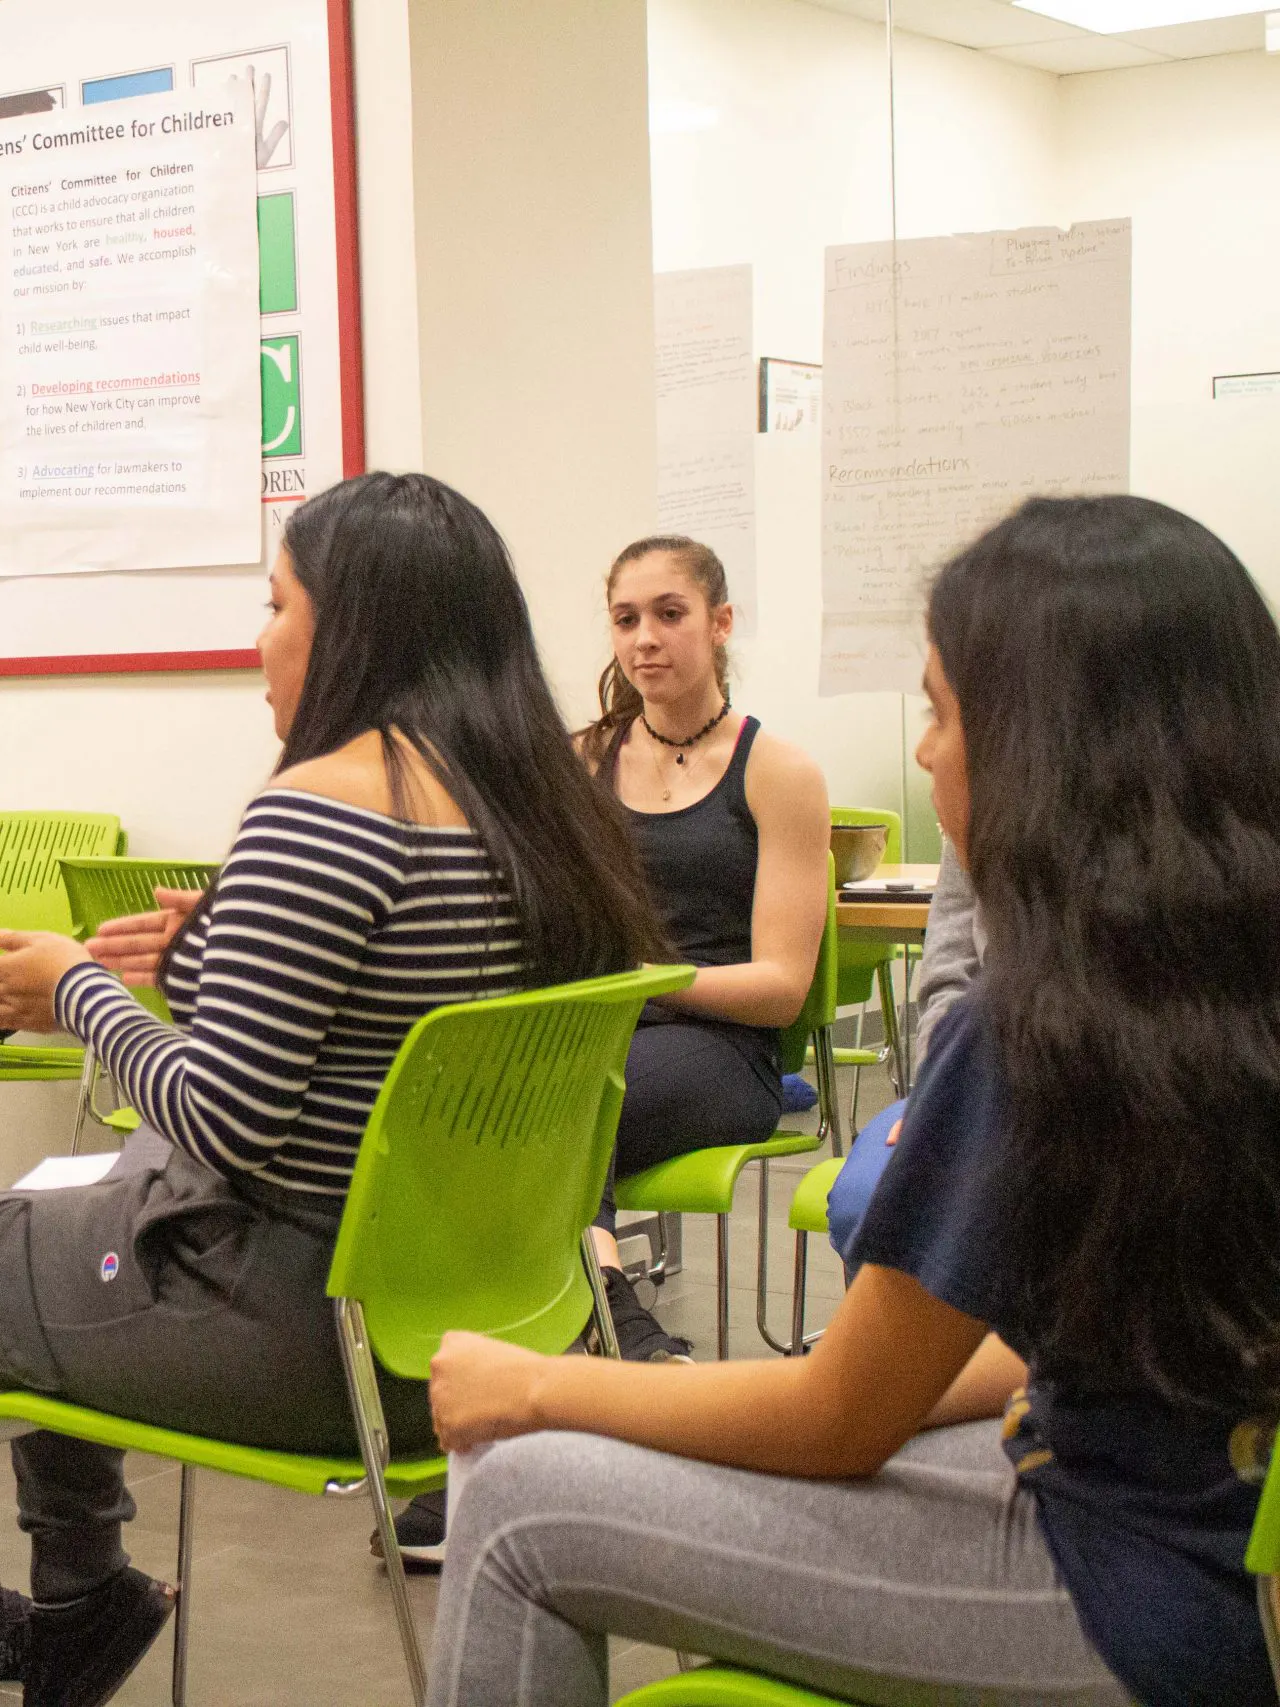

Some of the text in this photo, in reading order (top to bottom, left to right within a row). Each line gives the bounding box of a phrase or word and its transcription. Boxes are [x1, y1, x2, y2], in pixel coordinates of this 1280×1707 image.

[32, 124, 124, 151] Committee
[131, 120, 155, 138] for
[161, 110, 234, 134] Children
[61, 174, 117, 190] Committee
[126, 170, 141, 181] for
[150, 163, 194, 178] Children
[12, 184, 194, 219] (CCC) is a child advocacy organization
[12, 205, 195, 237] that works to ensure that all children
[13, 247, 22, 256] in
[28, 245, 50, 255] New
[56, 240, 78, 252] York
[84, 238, 100, 248] are
[66, 257, 84, 270] and
[117, 253, 134, 264] We
[139, 244, 196, 262] accomplish
[834, 257, 911, 291] Findings
[13, 287, 30, 297] our
[32, 282, 69, 294] mission
[31, 316, 97, 332] Researching
[100, 314, 129, 327] issues
[132, 312, 152, 323] that
[155, 308, 191, 323] impact
[18, 342, 41, 355] child
[17, 372, 200, 397] 2) Developing recommendations
[26, 394, 201, 415] for how New York City can improve
[26, 425, 41, 436] the
[45, 424, 66, 435] lives
[69, 420, 79, 433] of
[82, 420, 122, 432] children
[33, 464, 94, 477] Advocating
[98, 462, 112, 474] for
[114, 461, 168, 474] lawmakers
[171, 462, 182, 471] to
[829, 456, 970, 482] Recommendations
[19, 481, 186, 499] implement our recommendations
